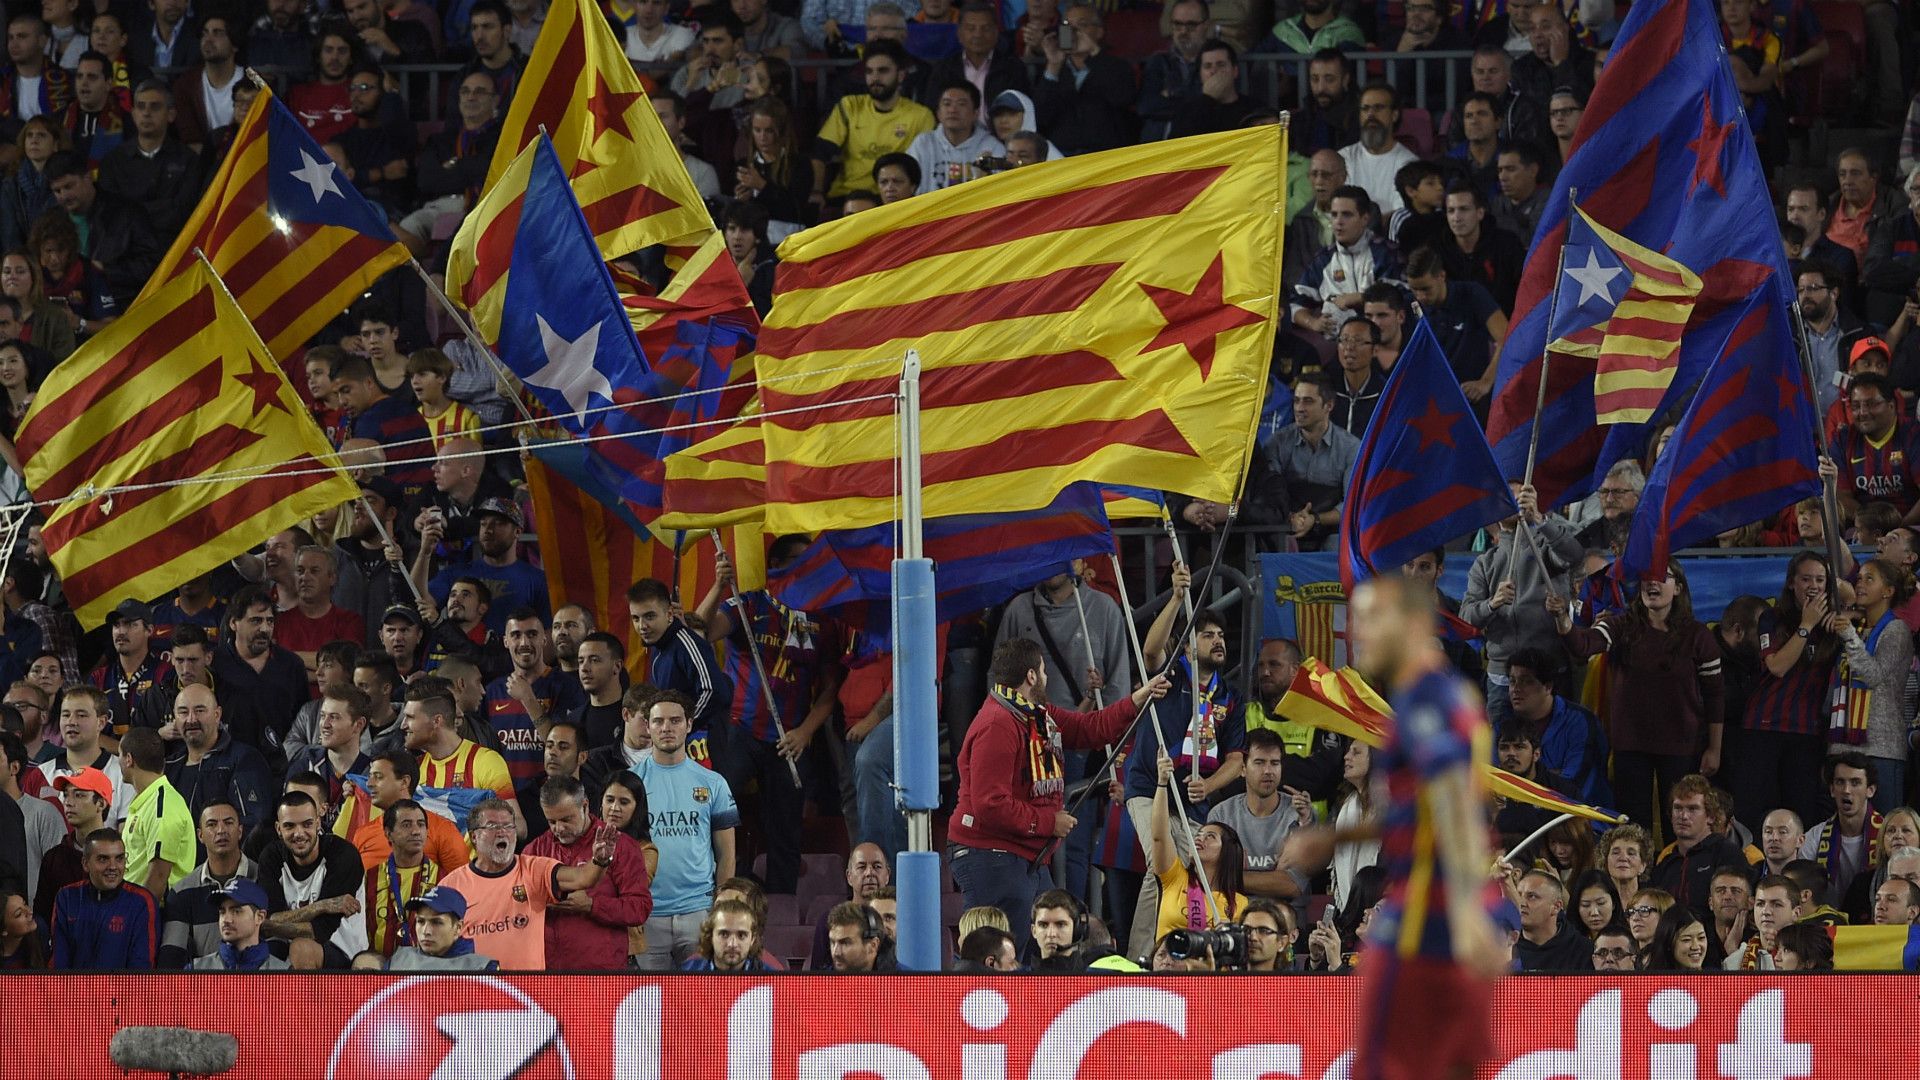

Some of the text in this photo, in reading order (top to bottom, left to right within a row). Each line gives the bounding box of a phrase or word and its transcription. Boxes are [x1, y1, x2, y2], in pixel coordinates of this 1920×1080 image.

[1855, 475, 1903, 490] QATAR
[1869, 487, 1901, 496] AIRW
[1304, 584, 1344, 595] Barcel
[755, 632, 784, 647] unic
[507, 742, 544, 751] AIRWAYS
[654, 826, 700, 837] AIRWAYS
[1190, 899, 1202, 928] FELIZ
[466, 915, 510, 936] unicef
